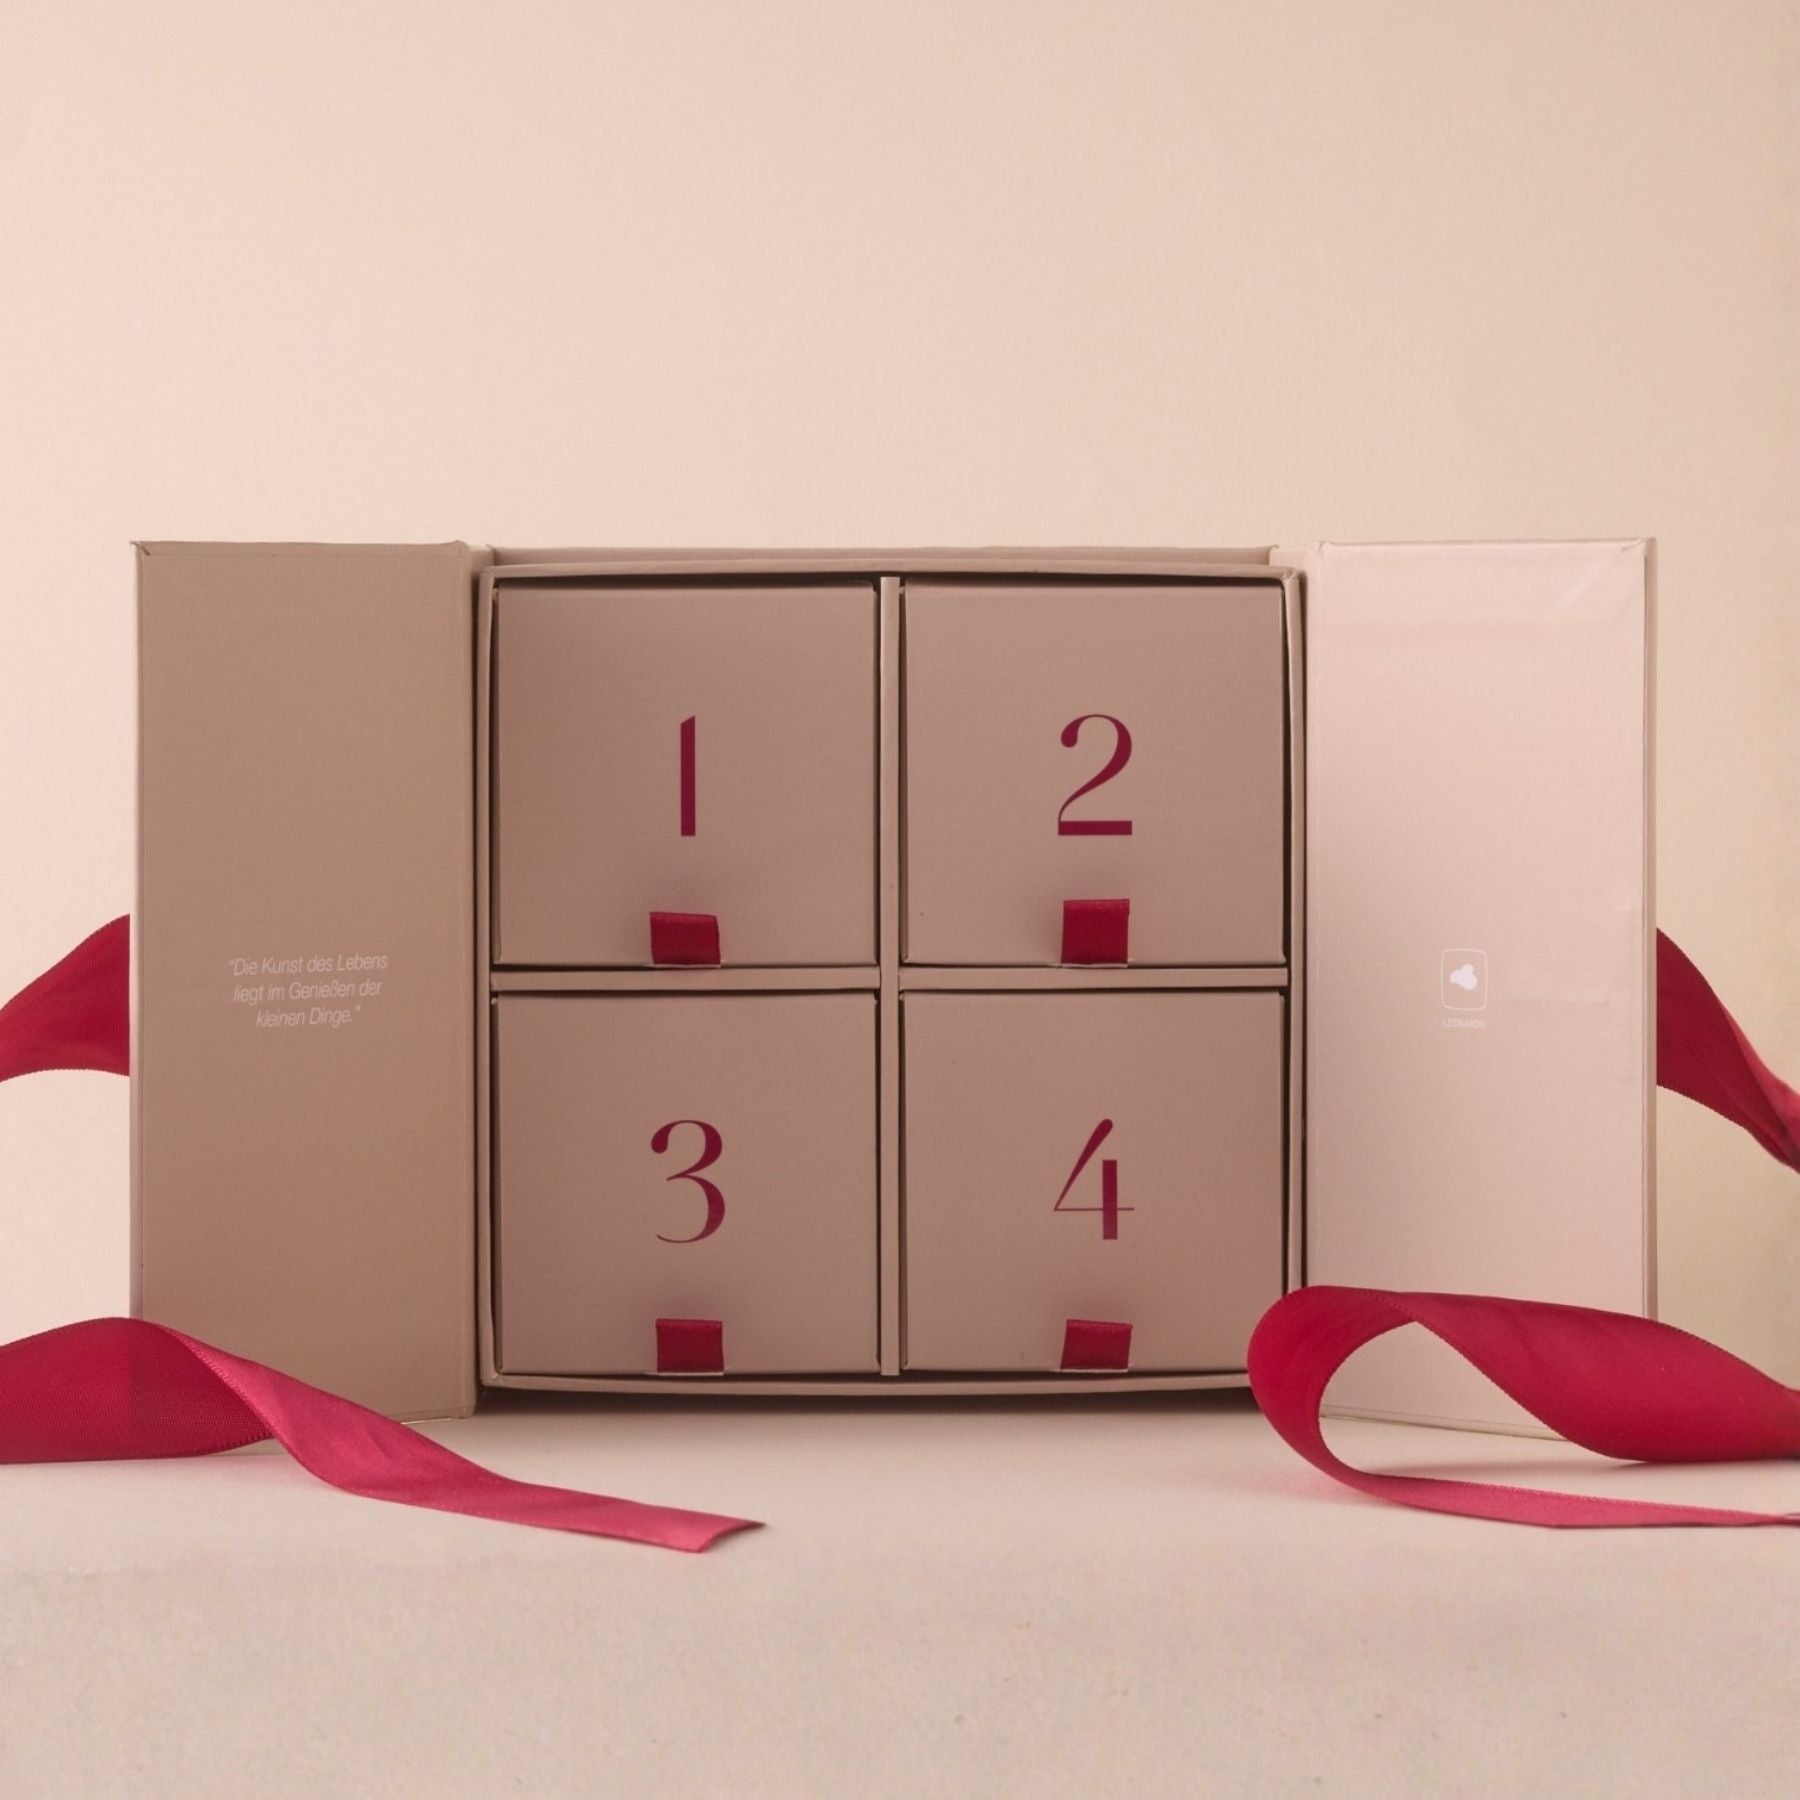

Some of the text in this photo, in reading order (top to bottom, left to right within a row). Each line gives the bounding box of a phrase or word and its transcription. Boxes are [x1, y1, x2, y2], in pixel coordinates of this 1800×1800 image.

[680, 716, 697, 836] 1
[1058, 714, 1132, 836] 2
[233, 979, 383, 1005] liegt im Genießen der
[256, 1010, 305, 1027] kleinen
[261, 956, 303, 974] Kunst
[307, 955, 333, 972] des
[336, 953, 388, 971] Lebens
[650, 1119, 727, 1243] 3
[1054, 1118, 1134, 1240] 4
